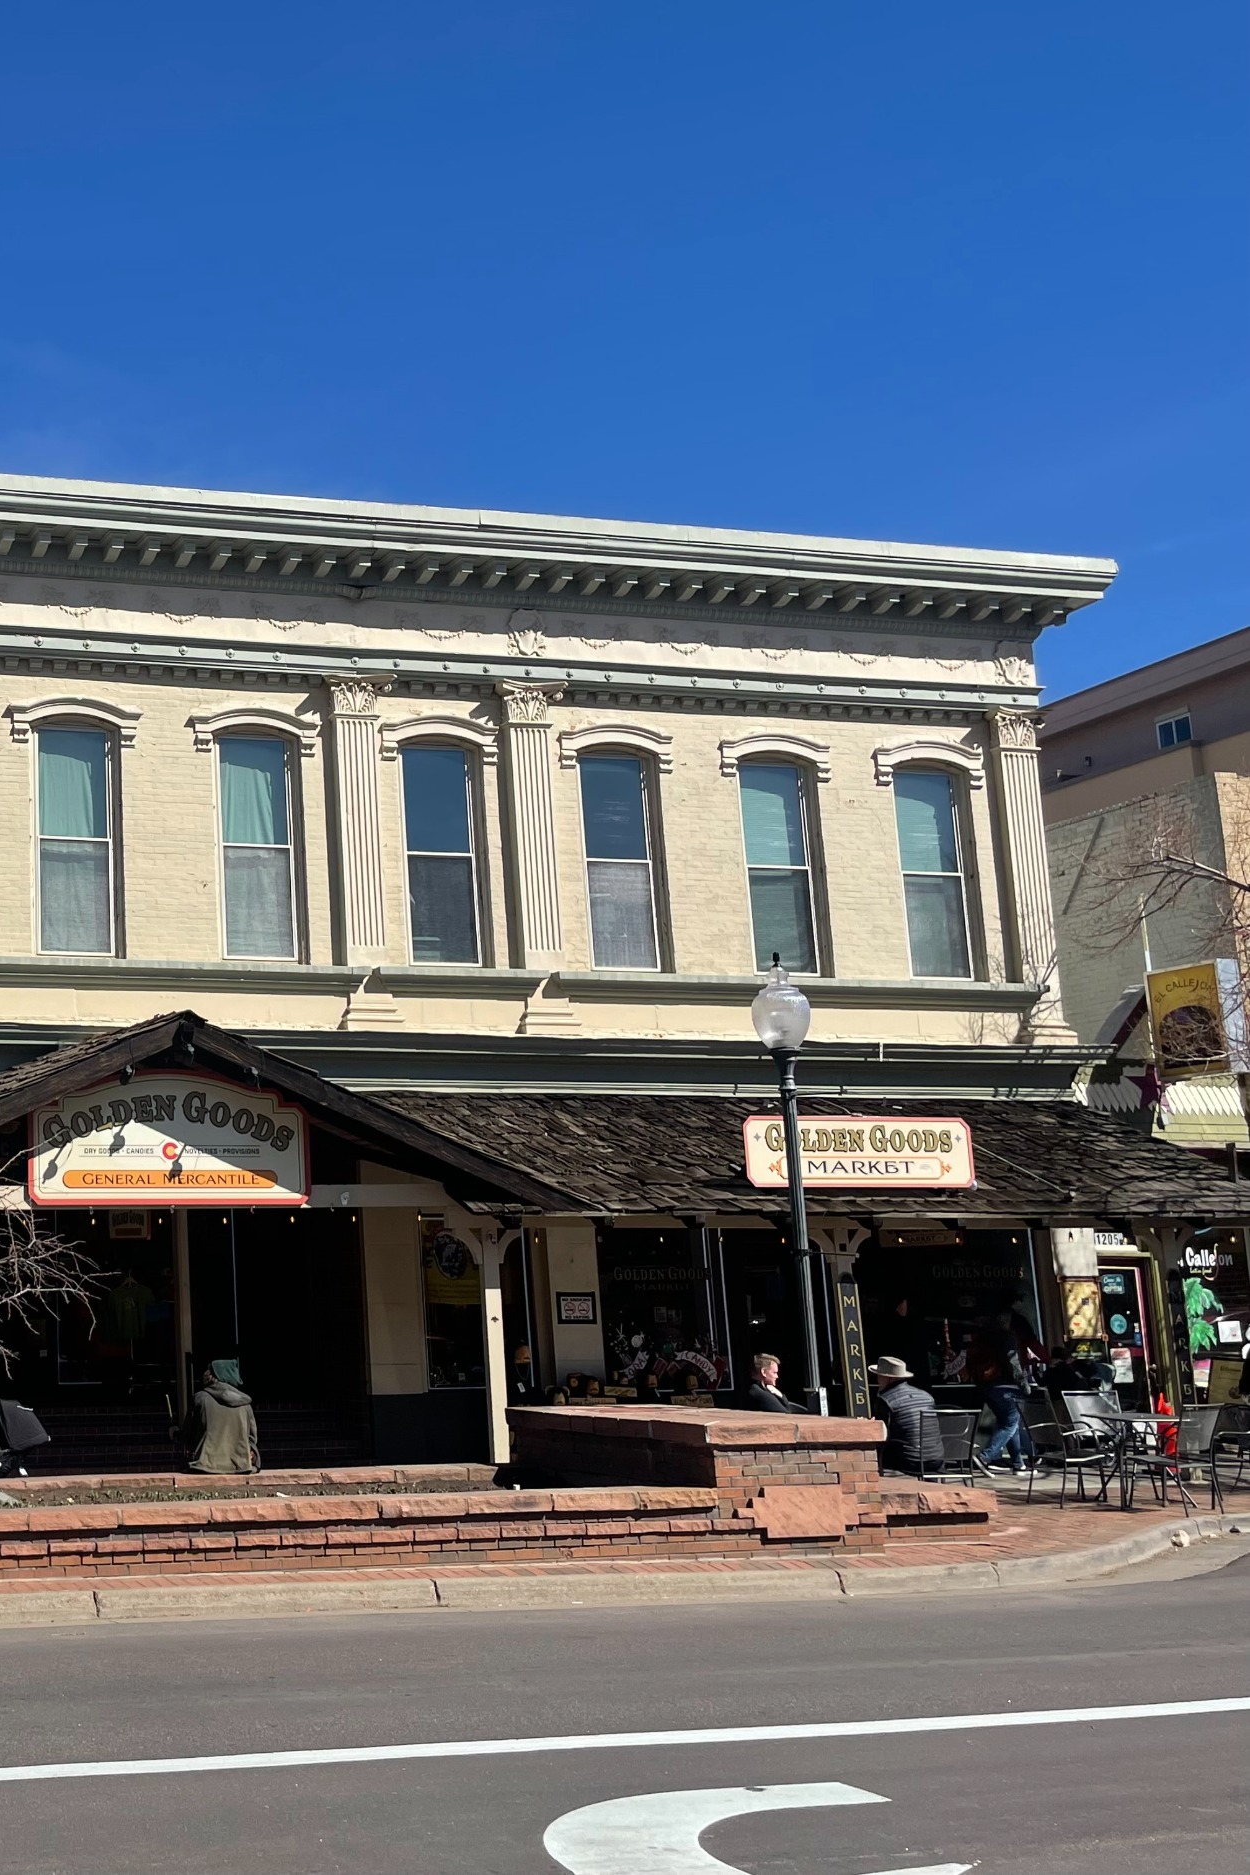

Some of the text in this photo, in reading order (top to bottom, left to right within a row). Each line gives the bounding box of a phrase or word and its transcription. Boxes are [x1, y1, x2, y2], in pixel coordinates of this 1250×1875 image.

[42, 1091, 295, 1152] GOLDEN GOODS
[764, 1123, 953, 1153] GLDEN GOODS
[807, 1160, 915, 1175] MARKET
[82, 1172, 260, 1186] GENERAL MERCANTILE
[613, 1266, 711, 1281] GOLDEN GOODS
[932, 1265, 1024, 1279] GOLDEN GOODS
[843, 1295, 865, 1405] MARKE
[629, 1357, 646, 1377] ODA
[685, 1352, 713, 1373] CANDY
